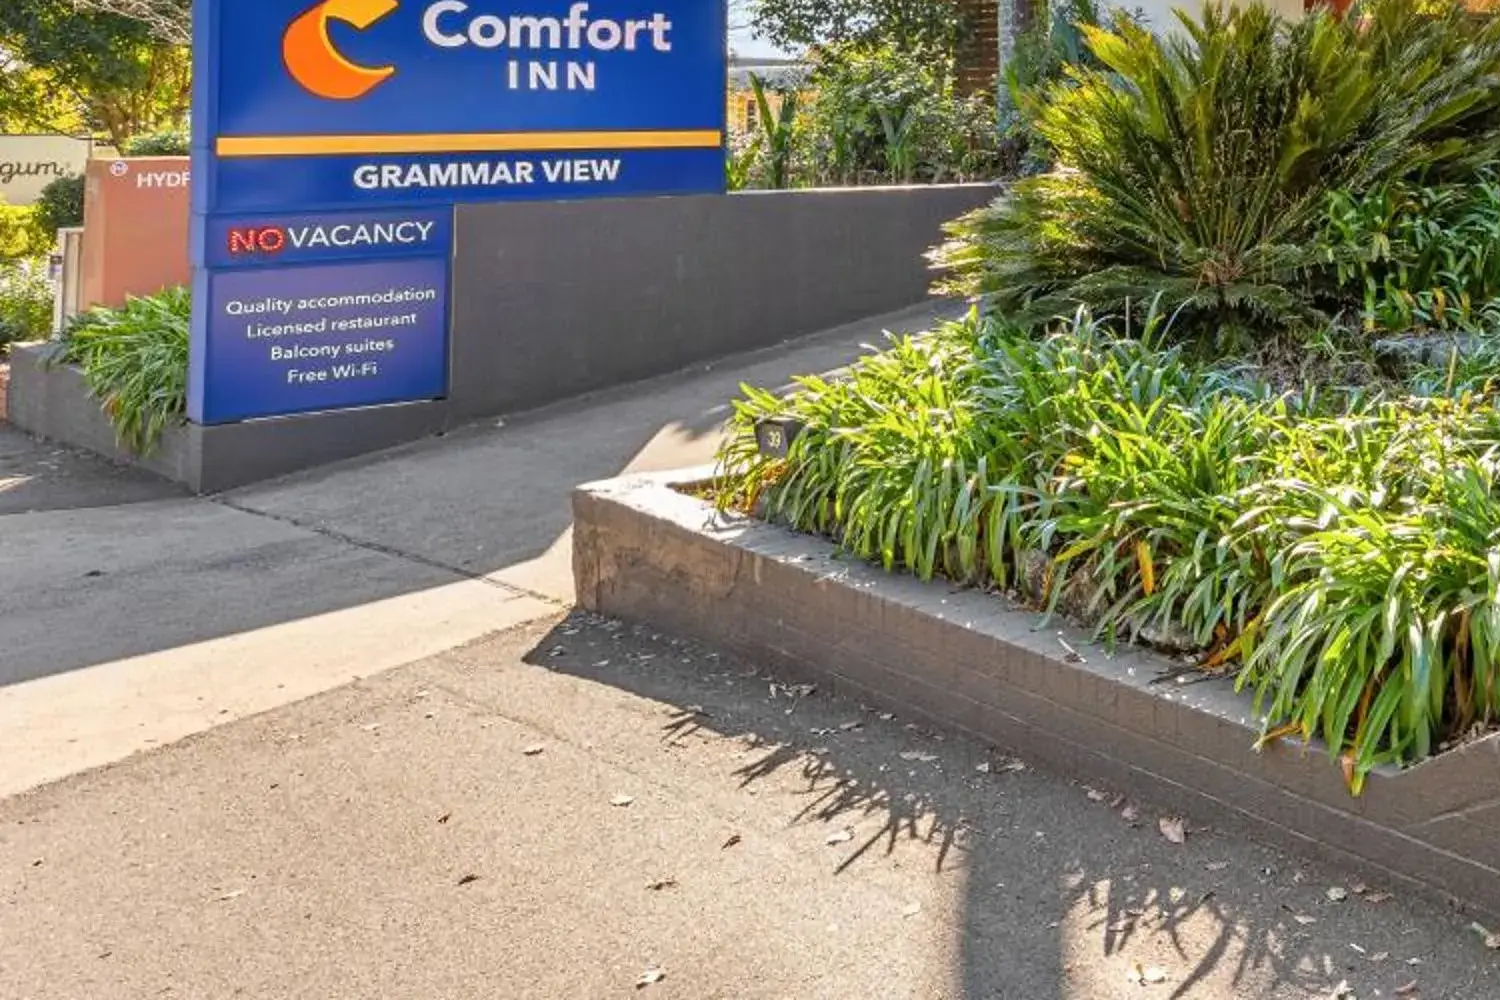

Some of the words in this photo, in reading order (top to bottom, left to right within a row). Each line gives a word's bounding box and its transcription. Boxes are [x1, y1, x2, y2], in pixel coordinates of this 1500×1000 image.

[422, 0, 673, 52] Comfort
[507, 60, 597, 91] INN
[352, 161, 534, 190] GRAMMAR
[541, 159, 622, 183] VIEW
[229, 226, 285, 253] NO
[287, 221, 434, 249] VACANCY
[226, 298, 293, 316] Quality
[297, 286, 437, 310] accommodation
[246, 318, 327, 339] Licensed
[331, 312, 417, 332] restaurant
[270, 344, 341, 361] Balcony
[345, 337, 395, 354] suites
[287, 369, 328, 384] Free
[332, 361, 378, 380] Wi-Fi
